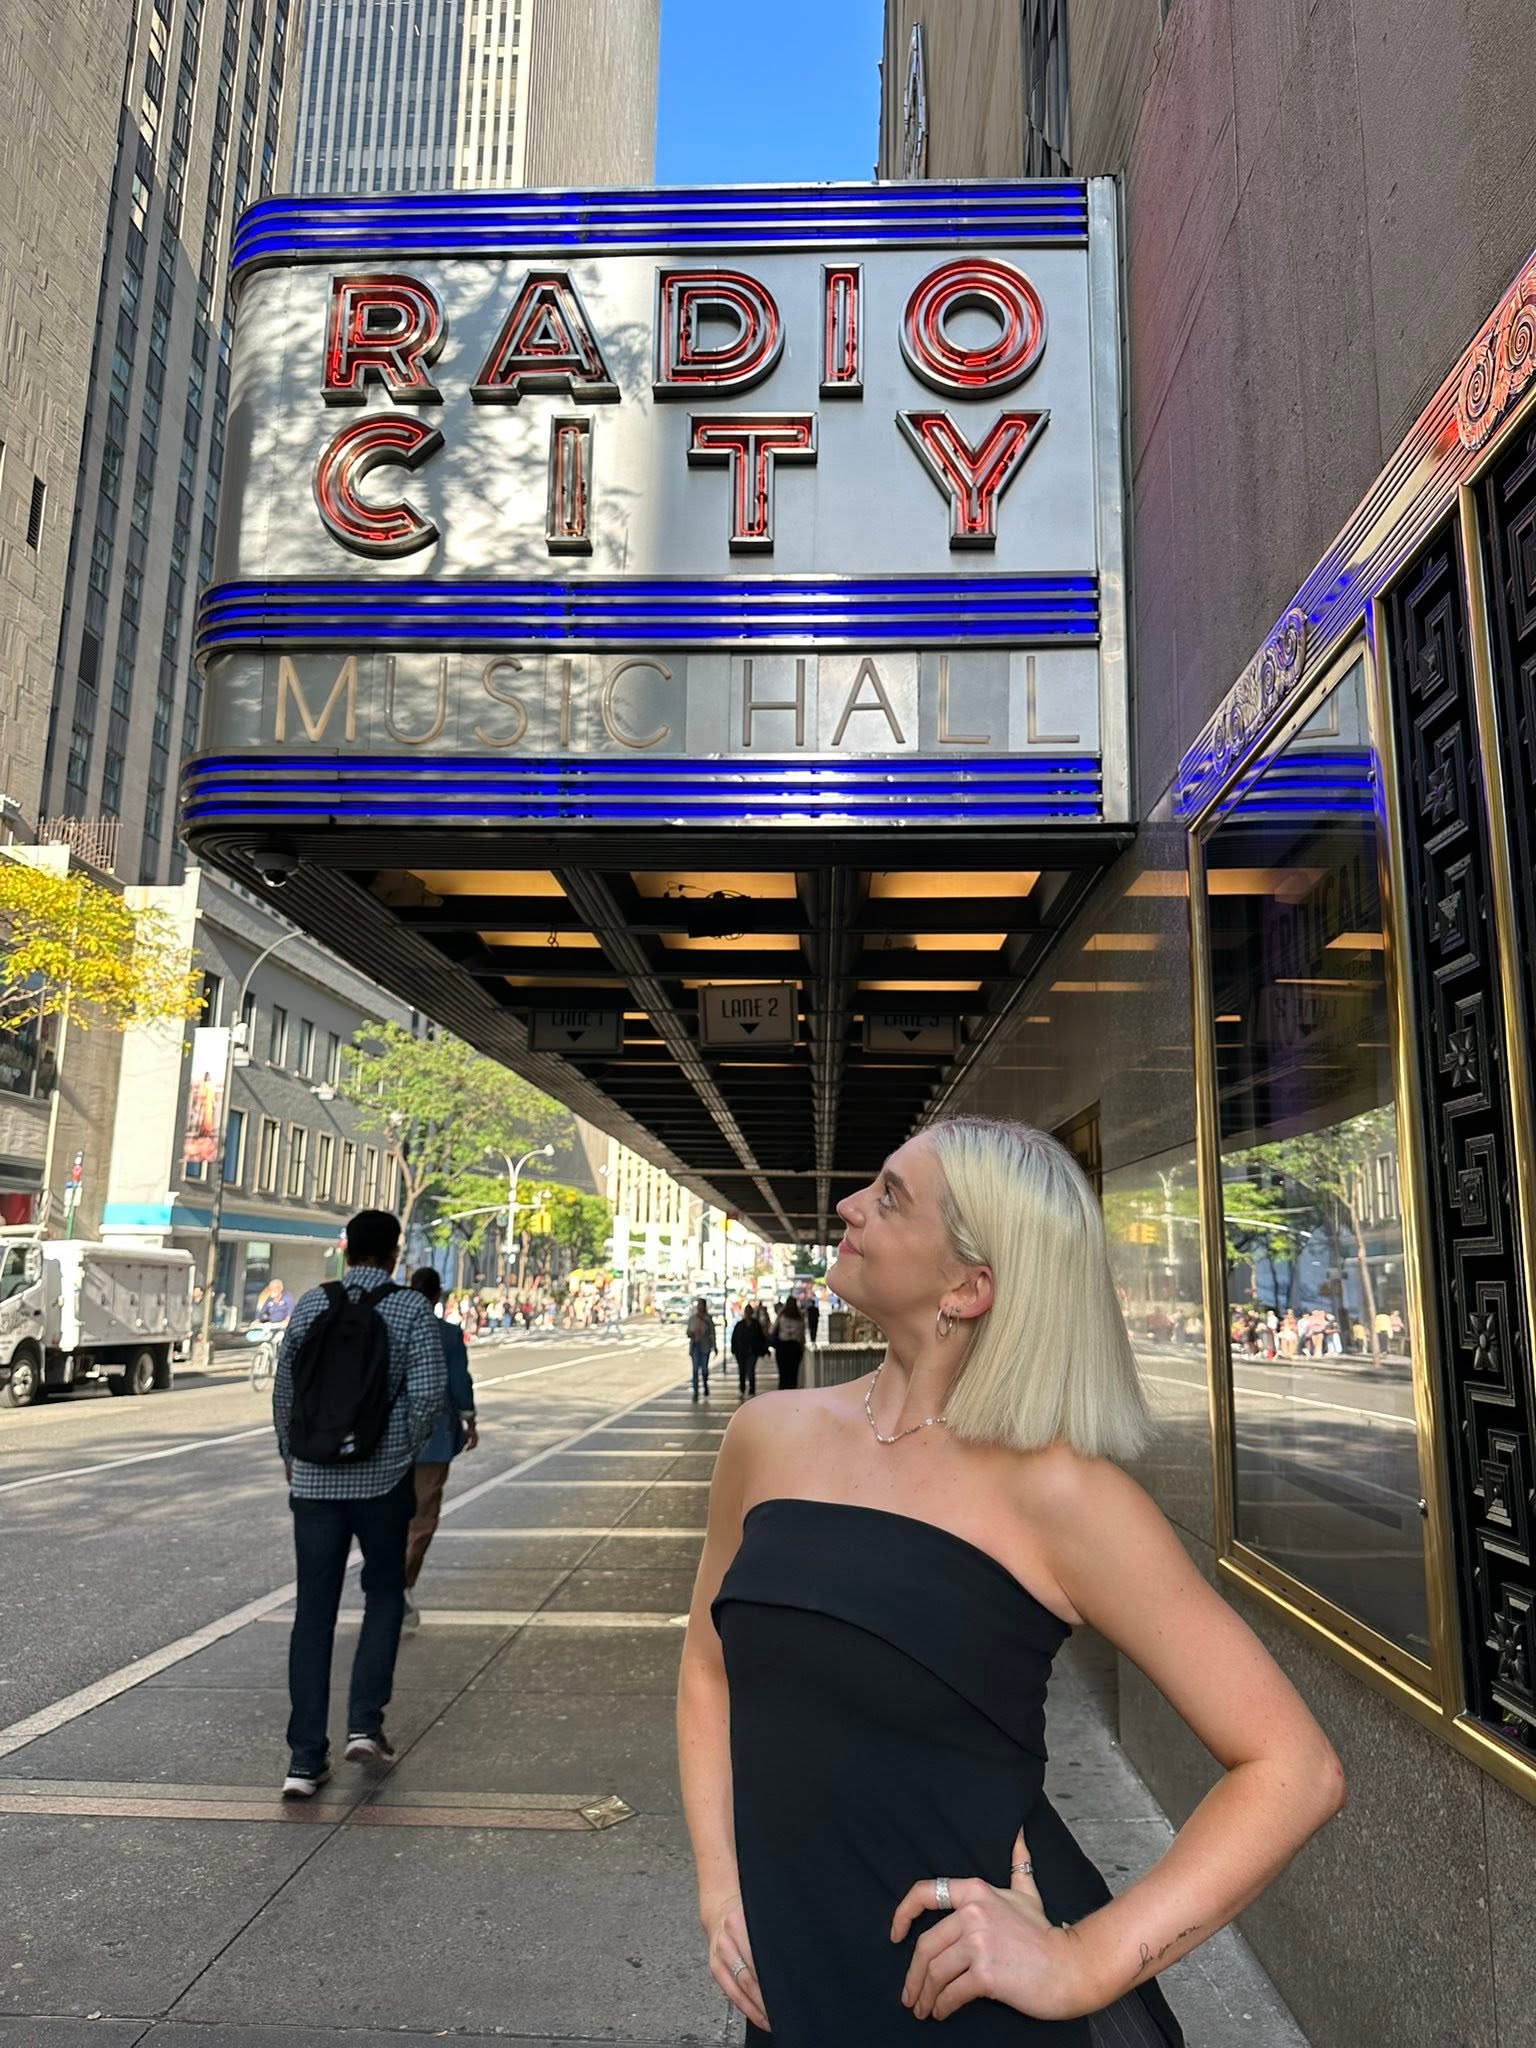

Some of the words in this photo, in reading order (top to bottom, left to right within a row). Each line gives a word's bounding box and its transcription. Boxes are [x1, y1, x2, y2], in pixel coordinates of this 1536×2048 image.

[319, 256, 1050, 405] RADIO
[314, 408, 1051, 560] CITY
[273, 654, 674, 750] MUSIC
[742, 656, 1080, 748] HALL
[721, 997, 763, 1018] LANE
[767, 996, 780, 1018] 2
